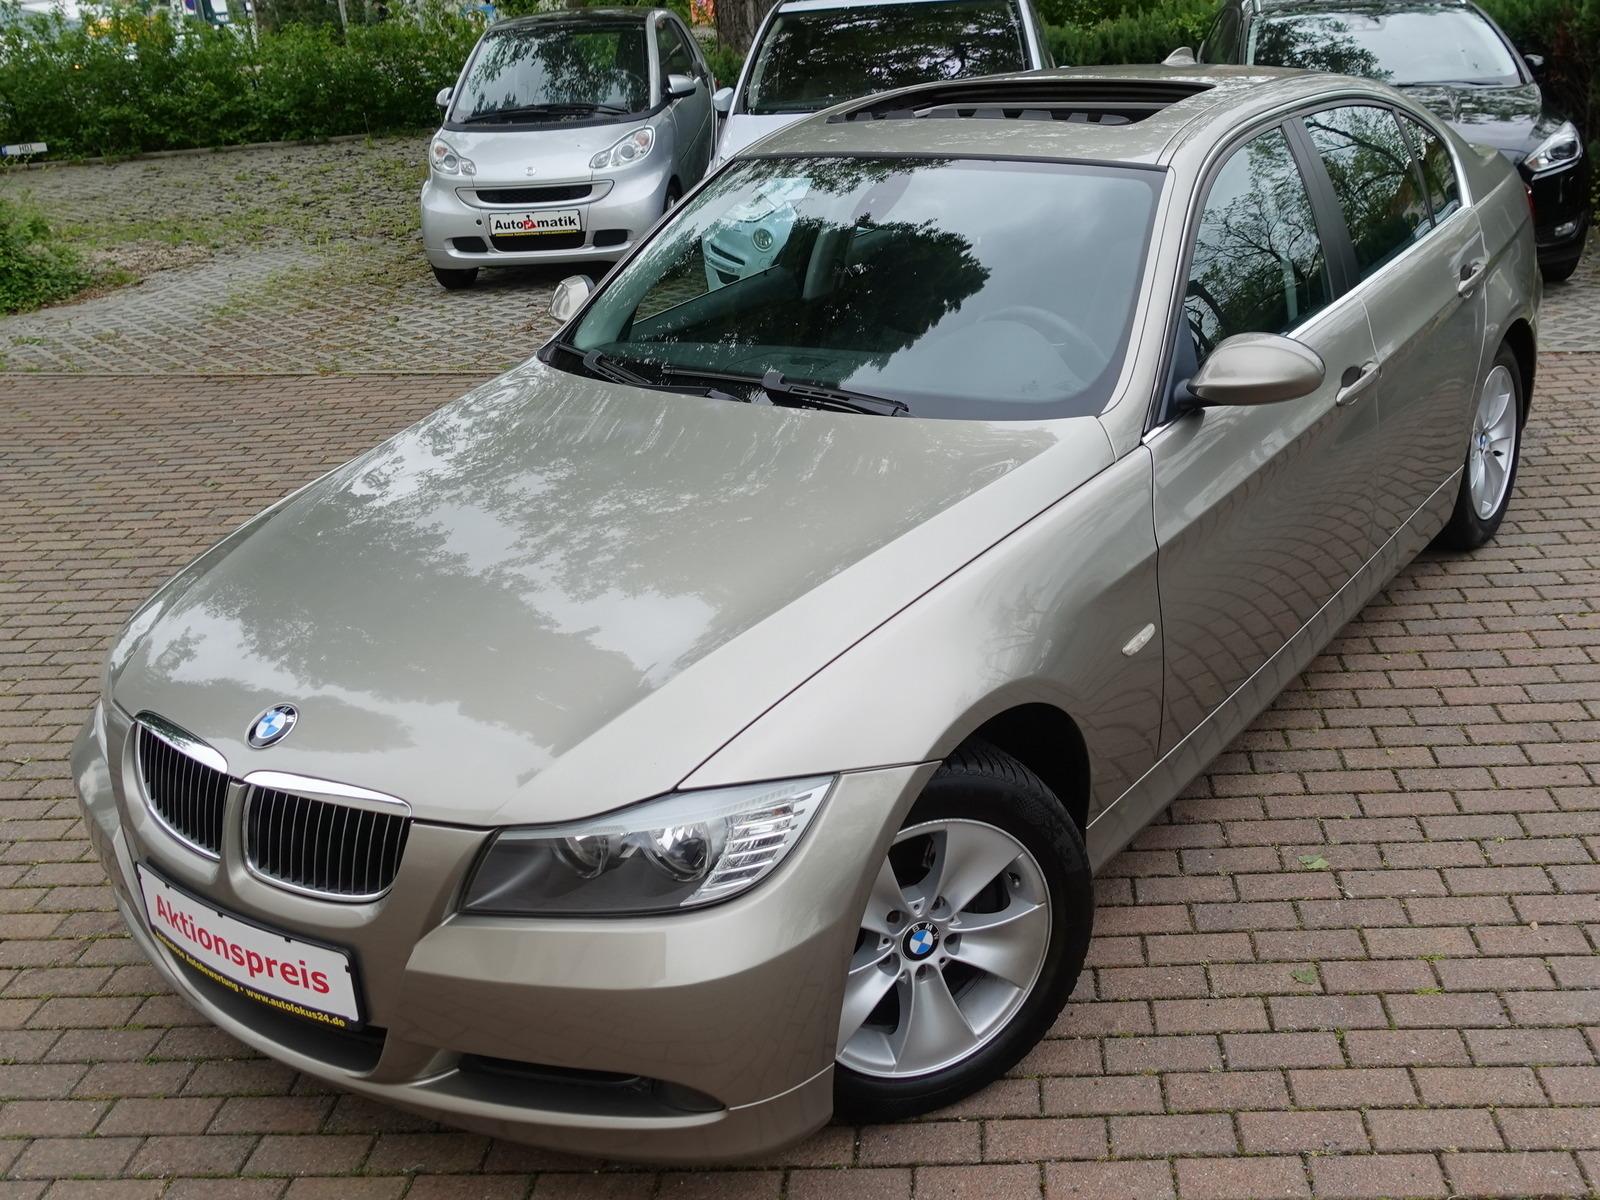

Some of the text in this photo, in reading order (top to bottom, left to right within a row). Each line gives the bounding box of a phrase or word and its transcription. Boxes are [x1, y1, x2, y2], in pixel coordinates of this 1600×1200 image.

[156, 894, 330, 994] Aktionspreis
[912, 923, 939, 940] BMW
[246, 988, 345, 1027] www.autofokus24.de
